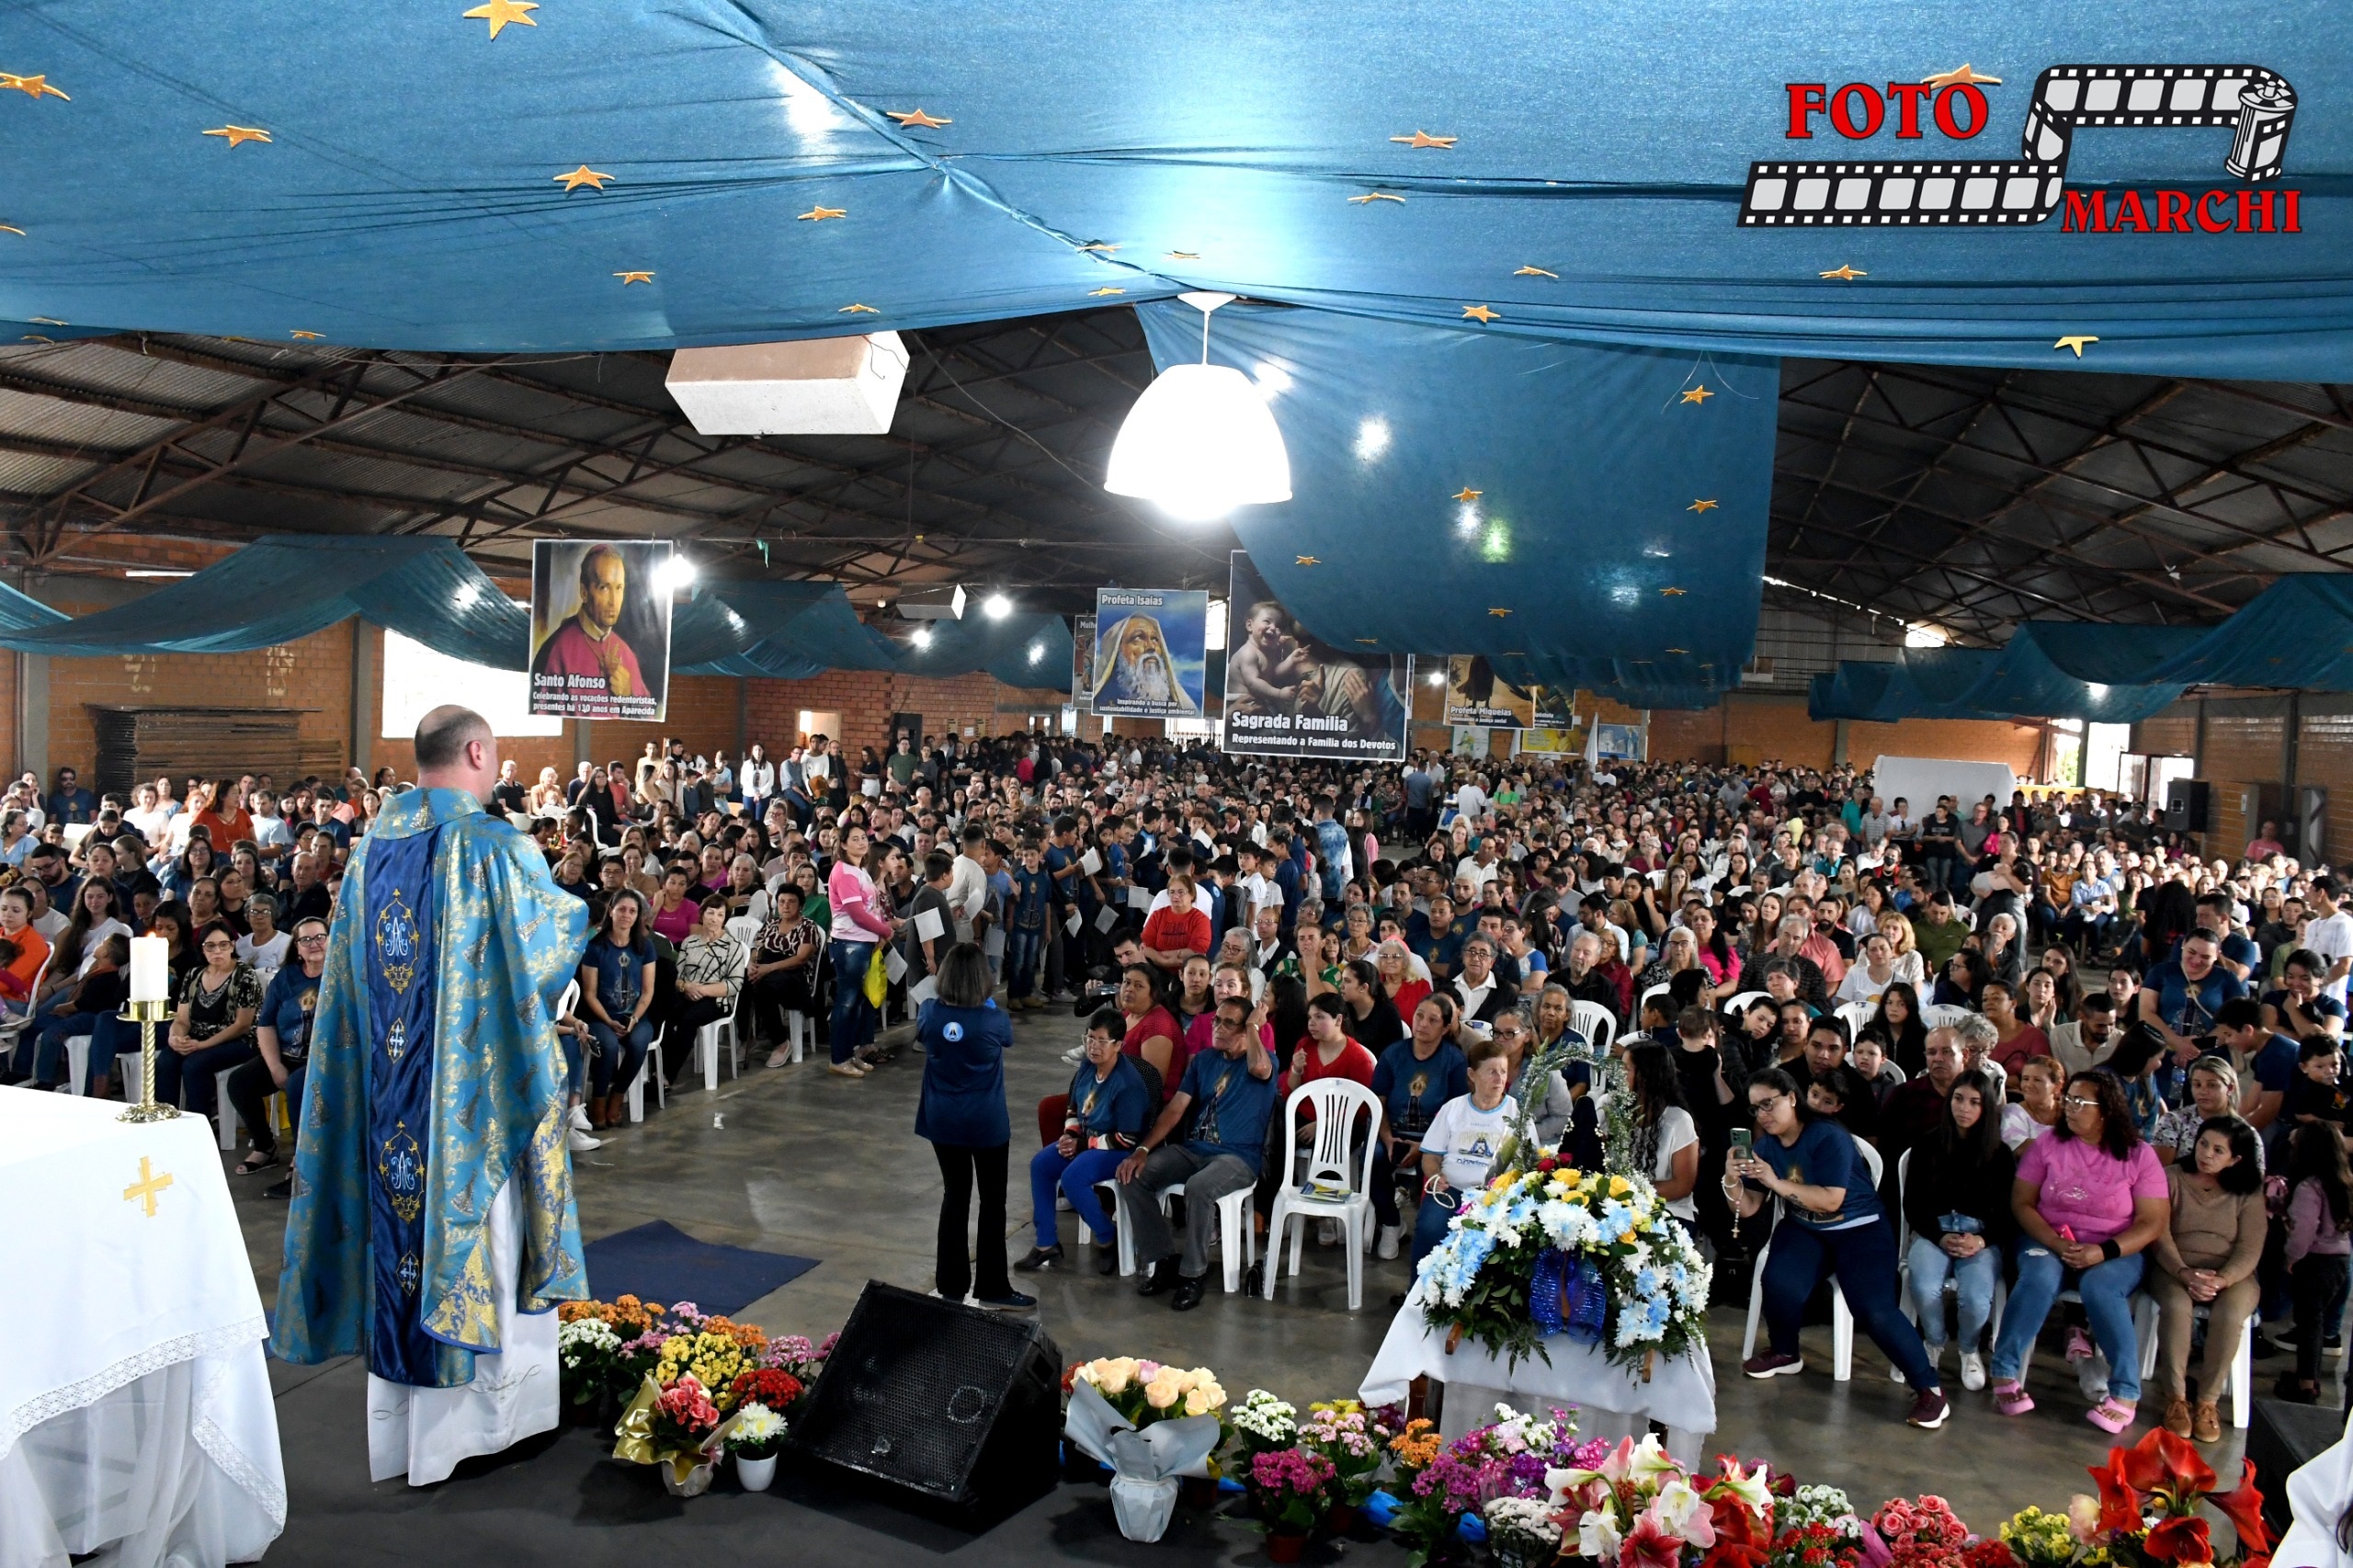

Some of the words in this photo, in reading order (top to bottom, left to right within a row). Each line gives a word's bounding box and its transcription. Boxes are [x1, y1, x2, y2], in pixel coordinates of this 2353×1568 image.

[1101, 594, 1135, 605] Profeta
[1137, 594, 1163, 606] Isaías
[1080, 620, 1097, 629] Mulh
[534, 673, 564, 687] Santo
[567, 674, 606, 689] Afonso
[533, 691, 569, 701] Celebrando
[580, 695, 608, 704] vocações
[610, 696, 657, 706] redentoristas,
[533, 702, 565, 712] presentes
[567, 703, 575, 711] há
[621, 706, 655, 716] Aparecida
[1450, 706, 1477, 714] Profeta
[1232, 711, 1291, 730] Sagrada
[1295, 713, 1348, 733] Família
[1232, 733, 1298, 746] Representando
[1308, 736, 1339, 747] Família
[1342, 738, 1358, 748] dos
[1359, 739, 1396, 750] Devotos
